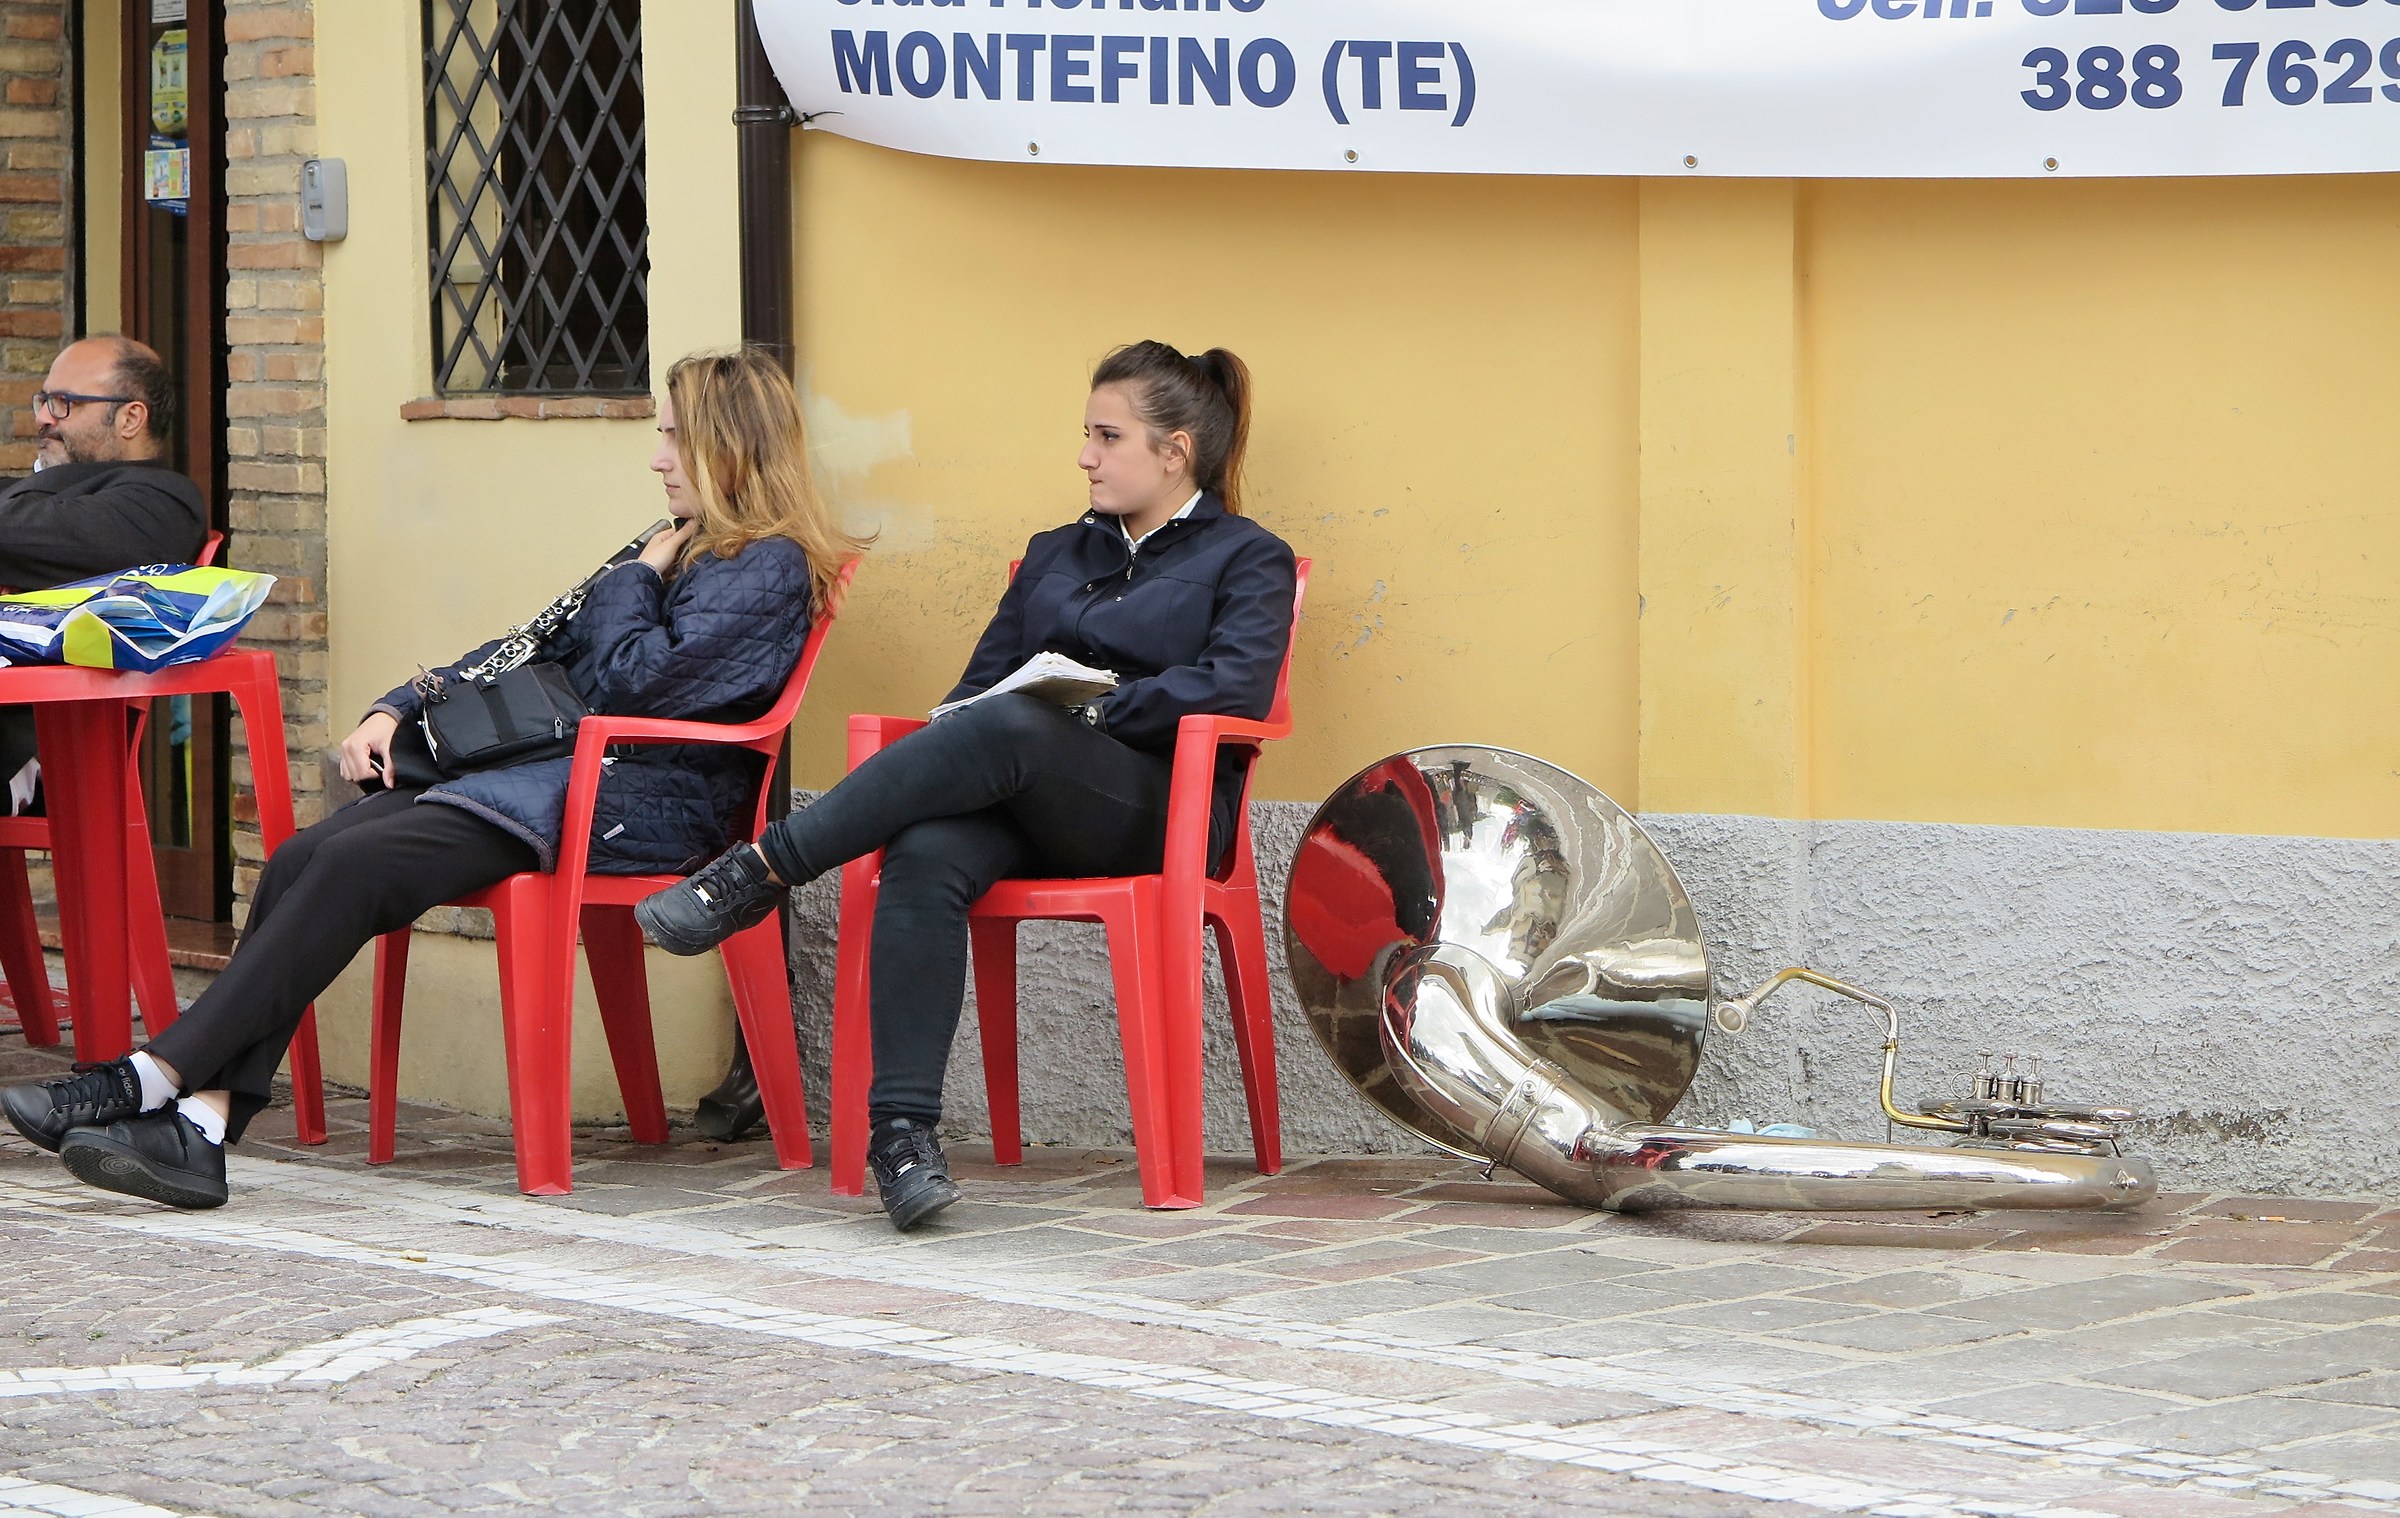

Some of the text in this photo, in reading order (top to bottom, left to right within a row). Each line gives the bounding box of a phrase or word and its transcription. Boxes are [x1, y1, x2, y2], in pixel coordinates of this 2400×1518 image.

[831, 30, 1476, 125] MONTEFINO (TE)
[2021, 45, 2180, 110] 388
